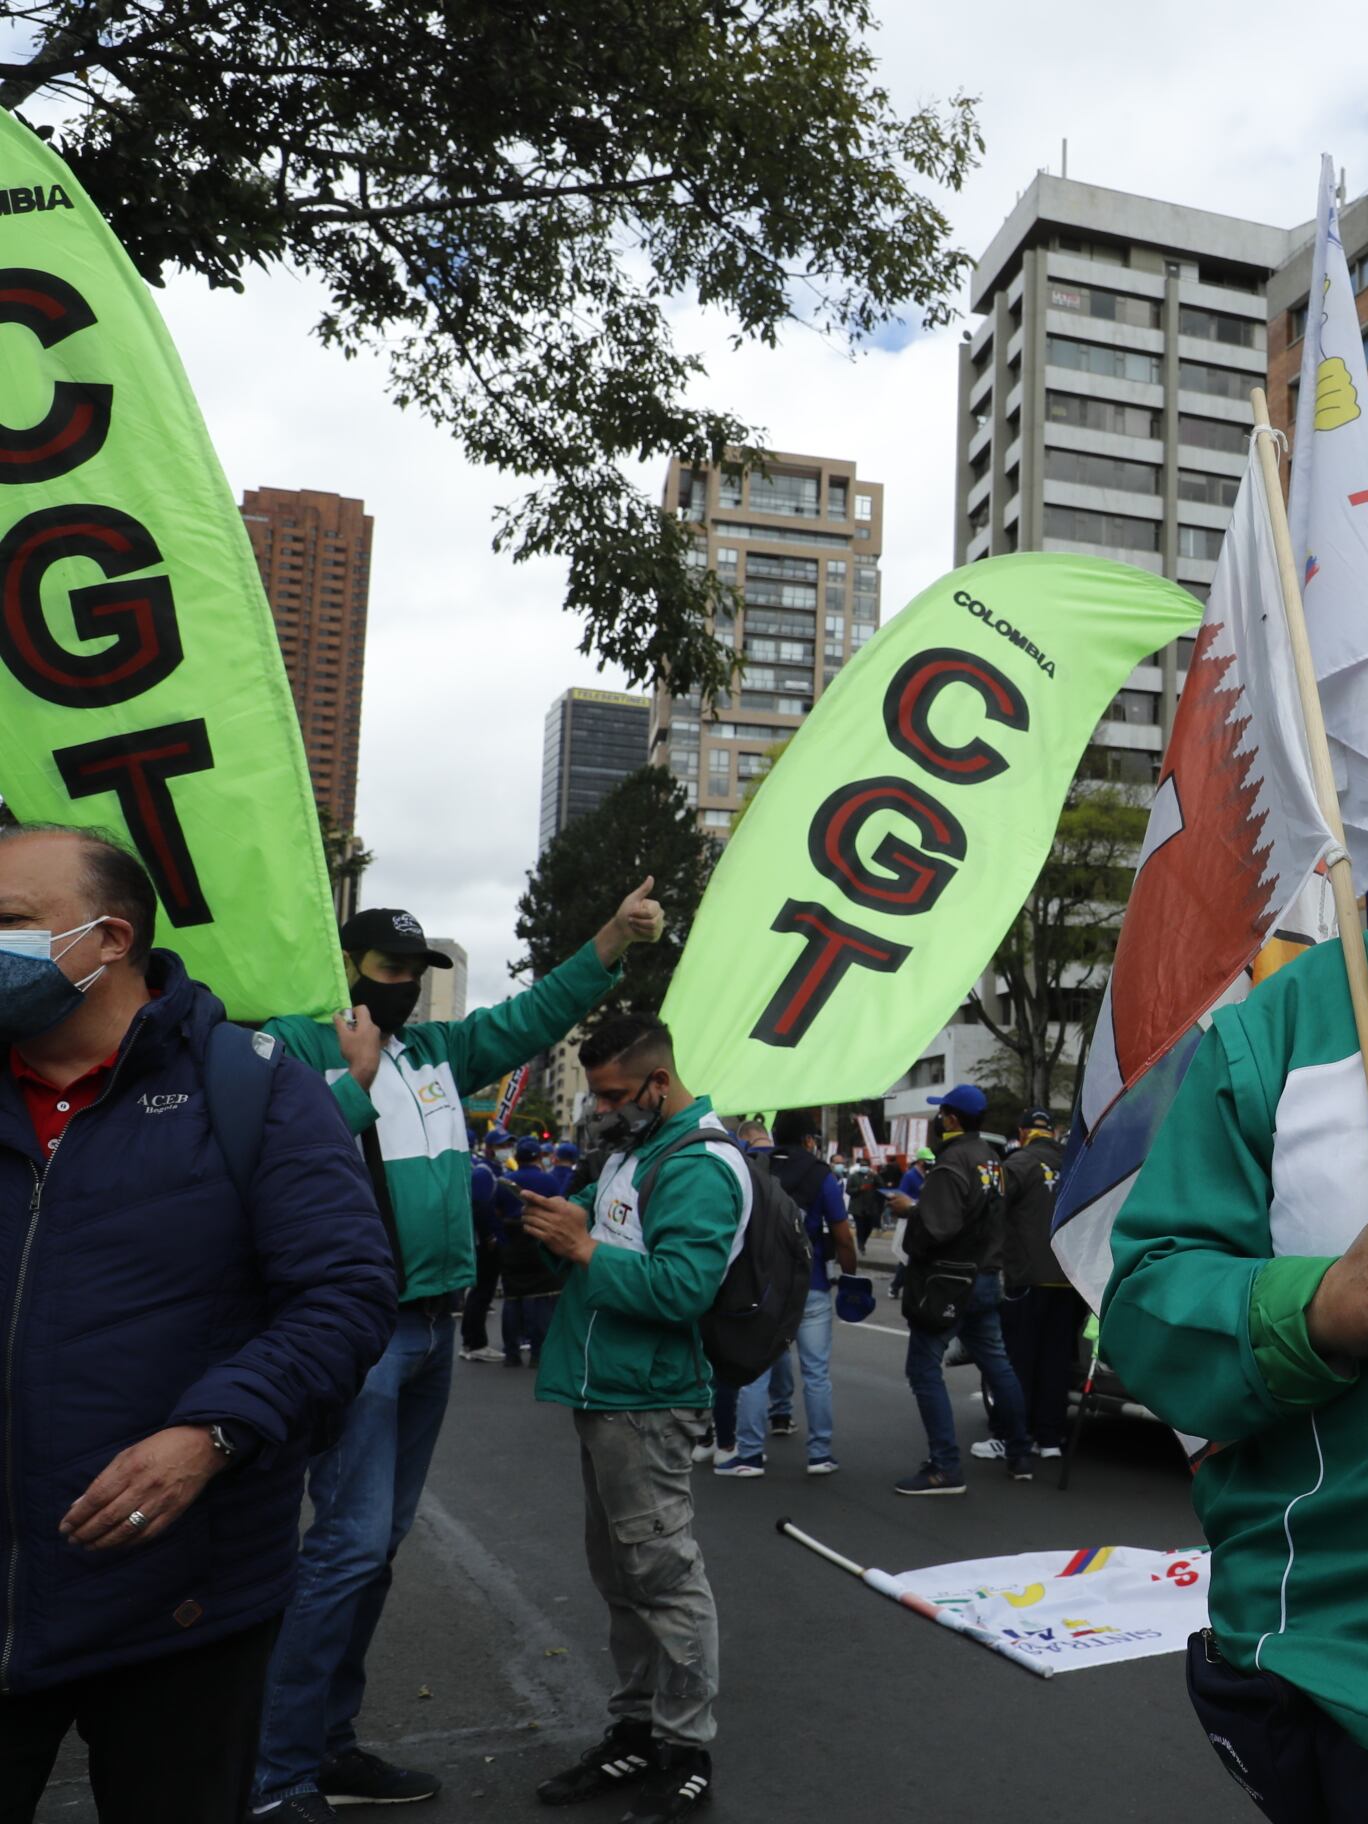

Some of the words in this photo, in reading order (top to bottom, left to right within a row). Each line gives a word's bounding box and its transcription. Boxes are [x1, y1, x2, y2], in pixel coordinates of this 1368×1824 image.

[0, 267, 215, 929] CGT
[953, 590, 1055, 680] COLOMBIA
[749, 647, 1030, 1048] CGT
